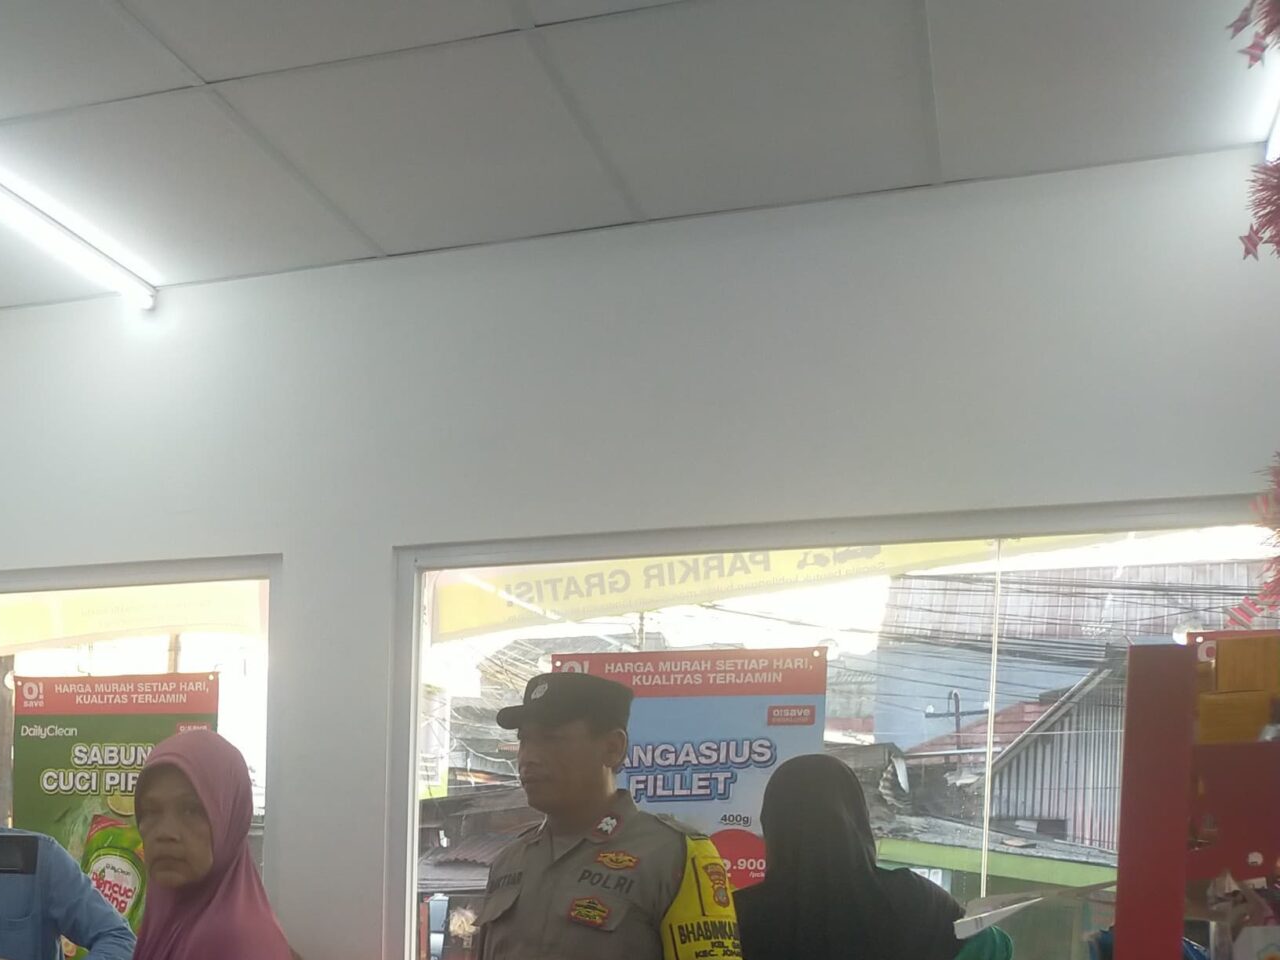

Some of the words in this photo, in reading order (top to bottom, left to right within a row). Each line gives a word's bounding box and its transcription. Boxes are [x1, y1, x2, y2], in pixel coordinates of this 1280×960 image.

[605, 662, 653, 673] HARGA
[658, 661, 711, 672] MURAH
[716, 660, 769, 671] SETIAP
[774, 659, 813, 671] HARI,
[632, 674, 703, 686] KUALITAS
[708, 672, 783, 684] TERJAMIN
[23, 682, 44, 700] O!
[55, 683, 92, 693] HARGA
[95, 683, 134, 693] MURAH
[137, 682, 176, 692] SETIAP
[179, 682, 209, 693] HARI,
[75, 694, 127, 705] KUALITAS
[131, 693, 187, 704] TERJAMIN
[20, 725, 78, 740] DailyClean
[73, 745, 152, 768] SABUN
[42, 771, 97, 793] CUCI
[630, 772, 731, 797] FILLET
[721, 814, 750, 825] 400g
[578, 869, 635, 894] POLRI
